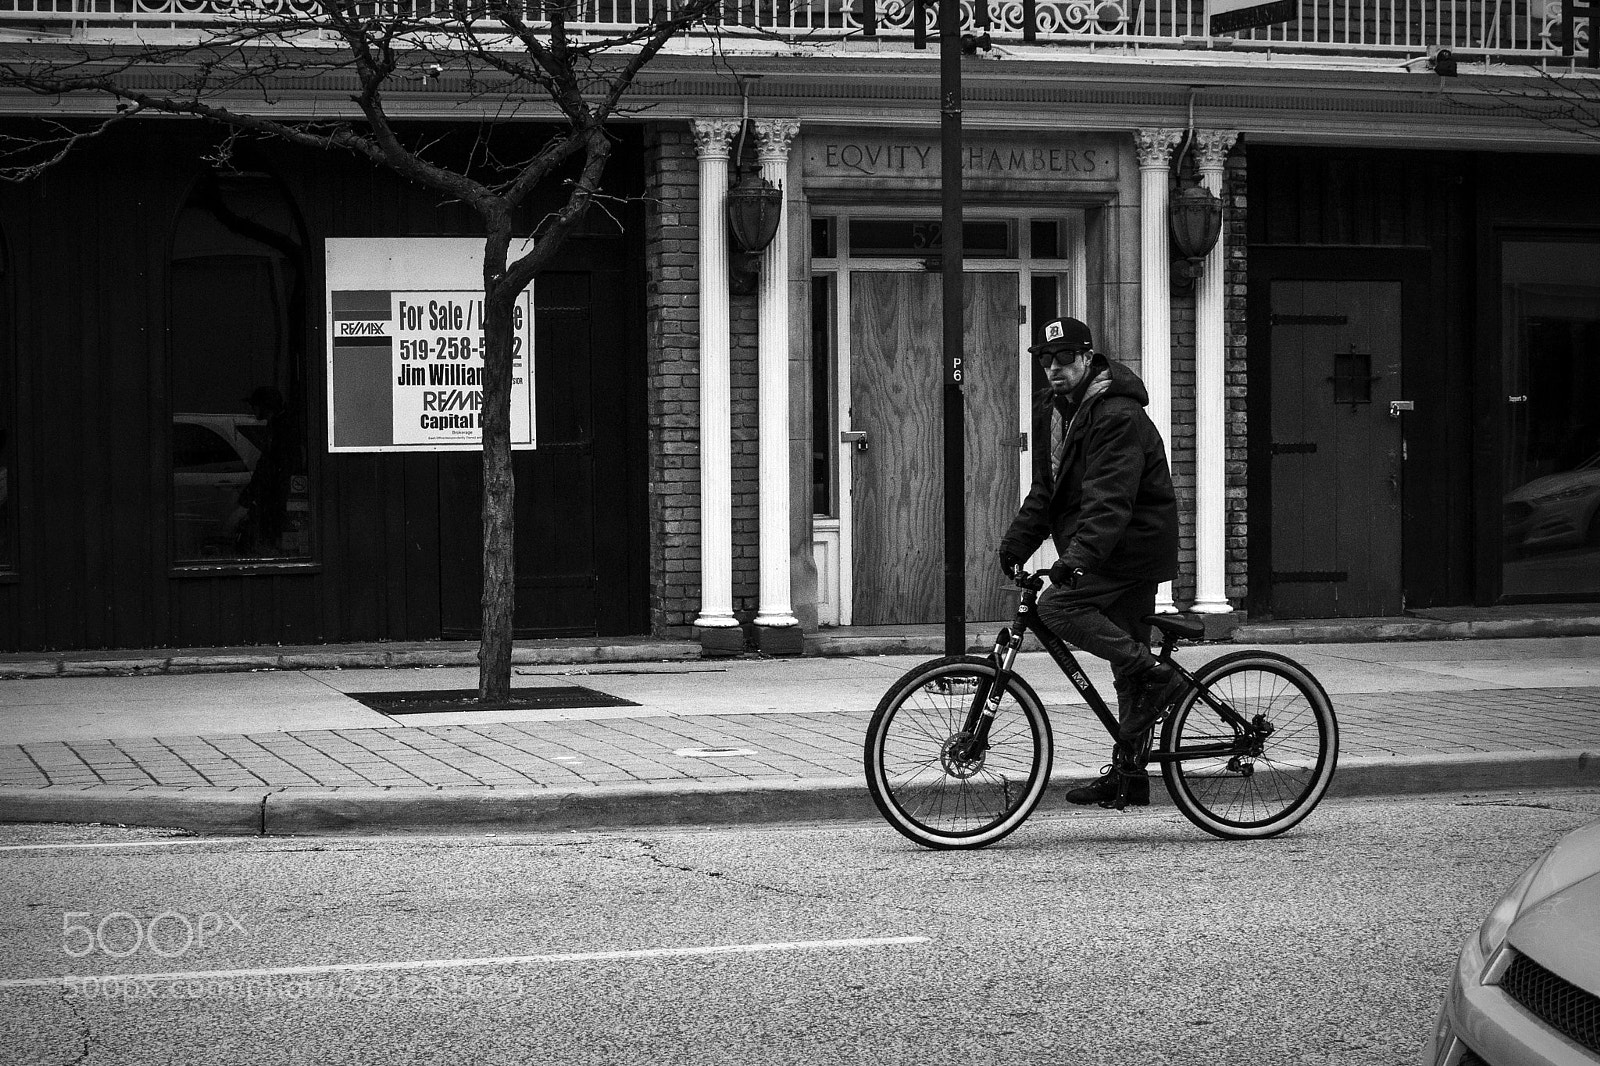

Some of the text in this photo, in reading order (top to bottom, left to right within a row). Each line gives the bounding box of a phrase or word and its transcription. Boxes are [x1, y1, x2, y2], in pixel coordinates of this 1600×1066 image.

[825, 143, 932, 175] EQVITY
[399, 300, 424, 331] For
[428, 299, 463, 331] Sale
[466, 299, 474, 331] /
[340, 321, 385, 335] RE/MAX
[399, 336, 522, 360] 519-258-52
[953, 357, 962, 369] P
[397, 363, 426, 386] Jim
[953, 369, 962, 382] 6
[420, 412, 474, 431] Capital
